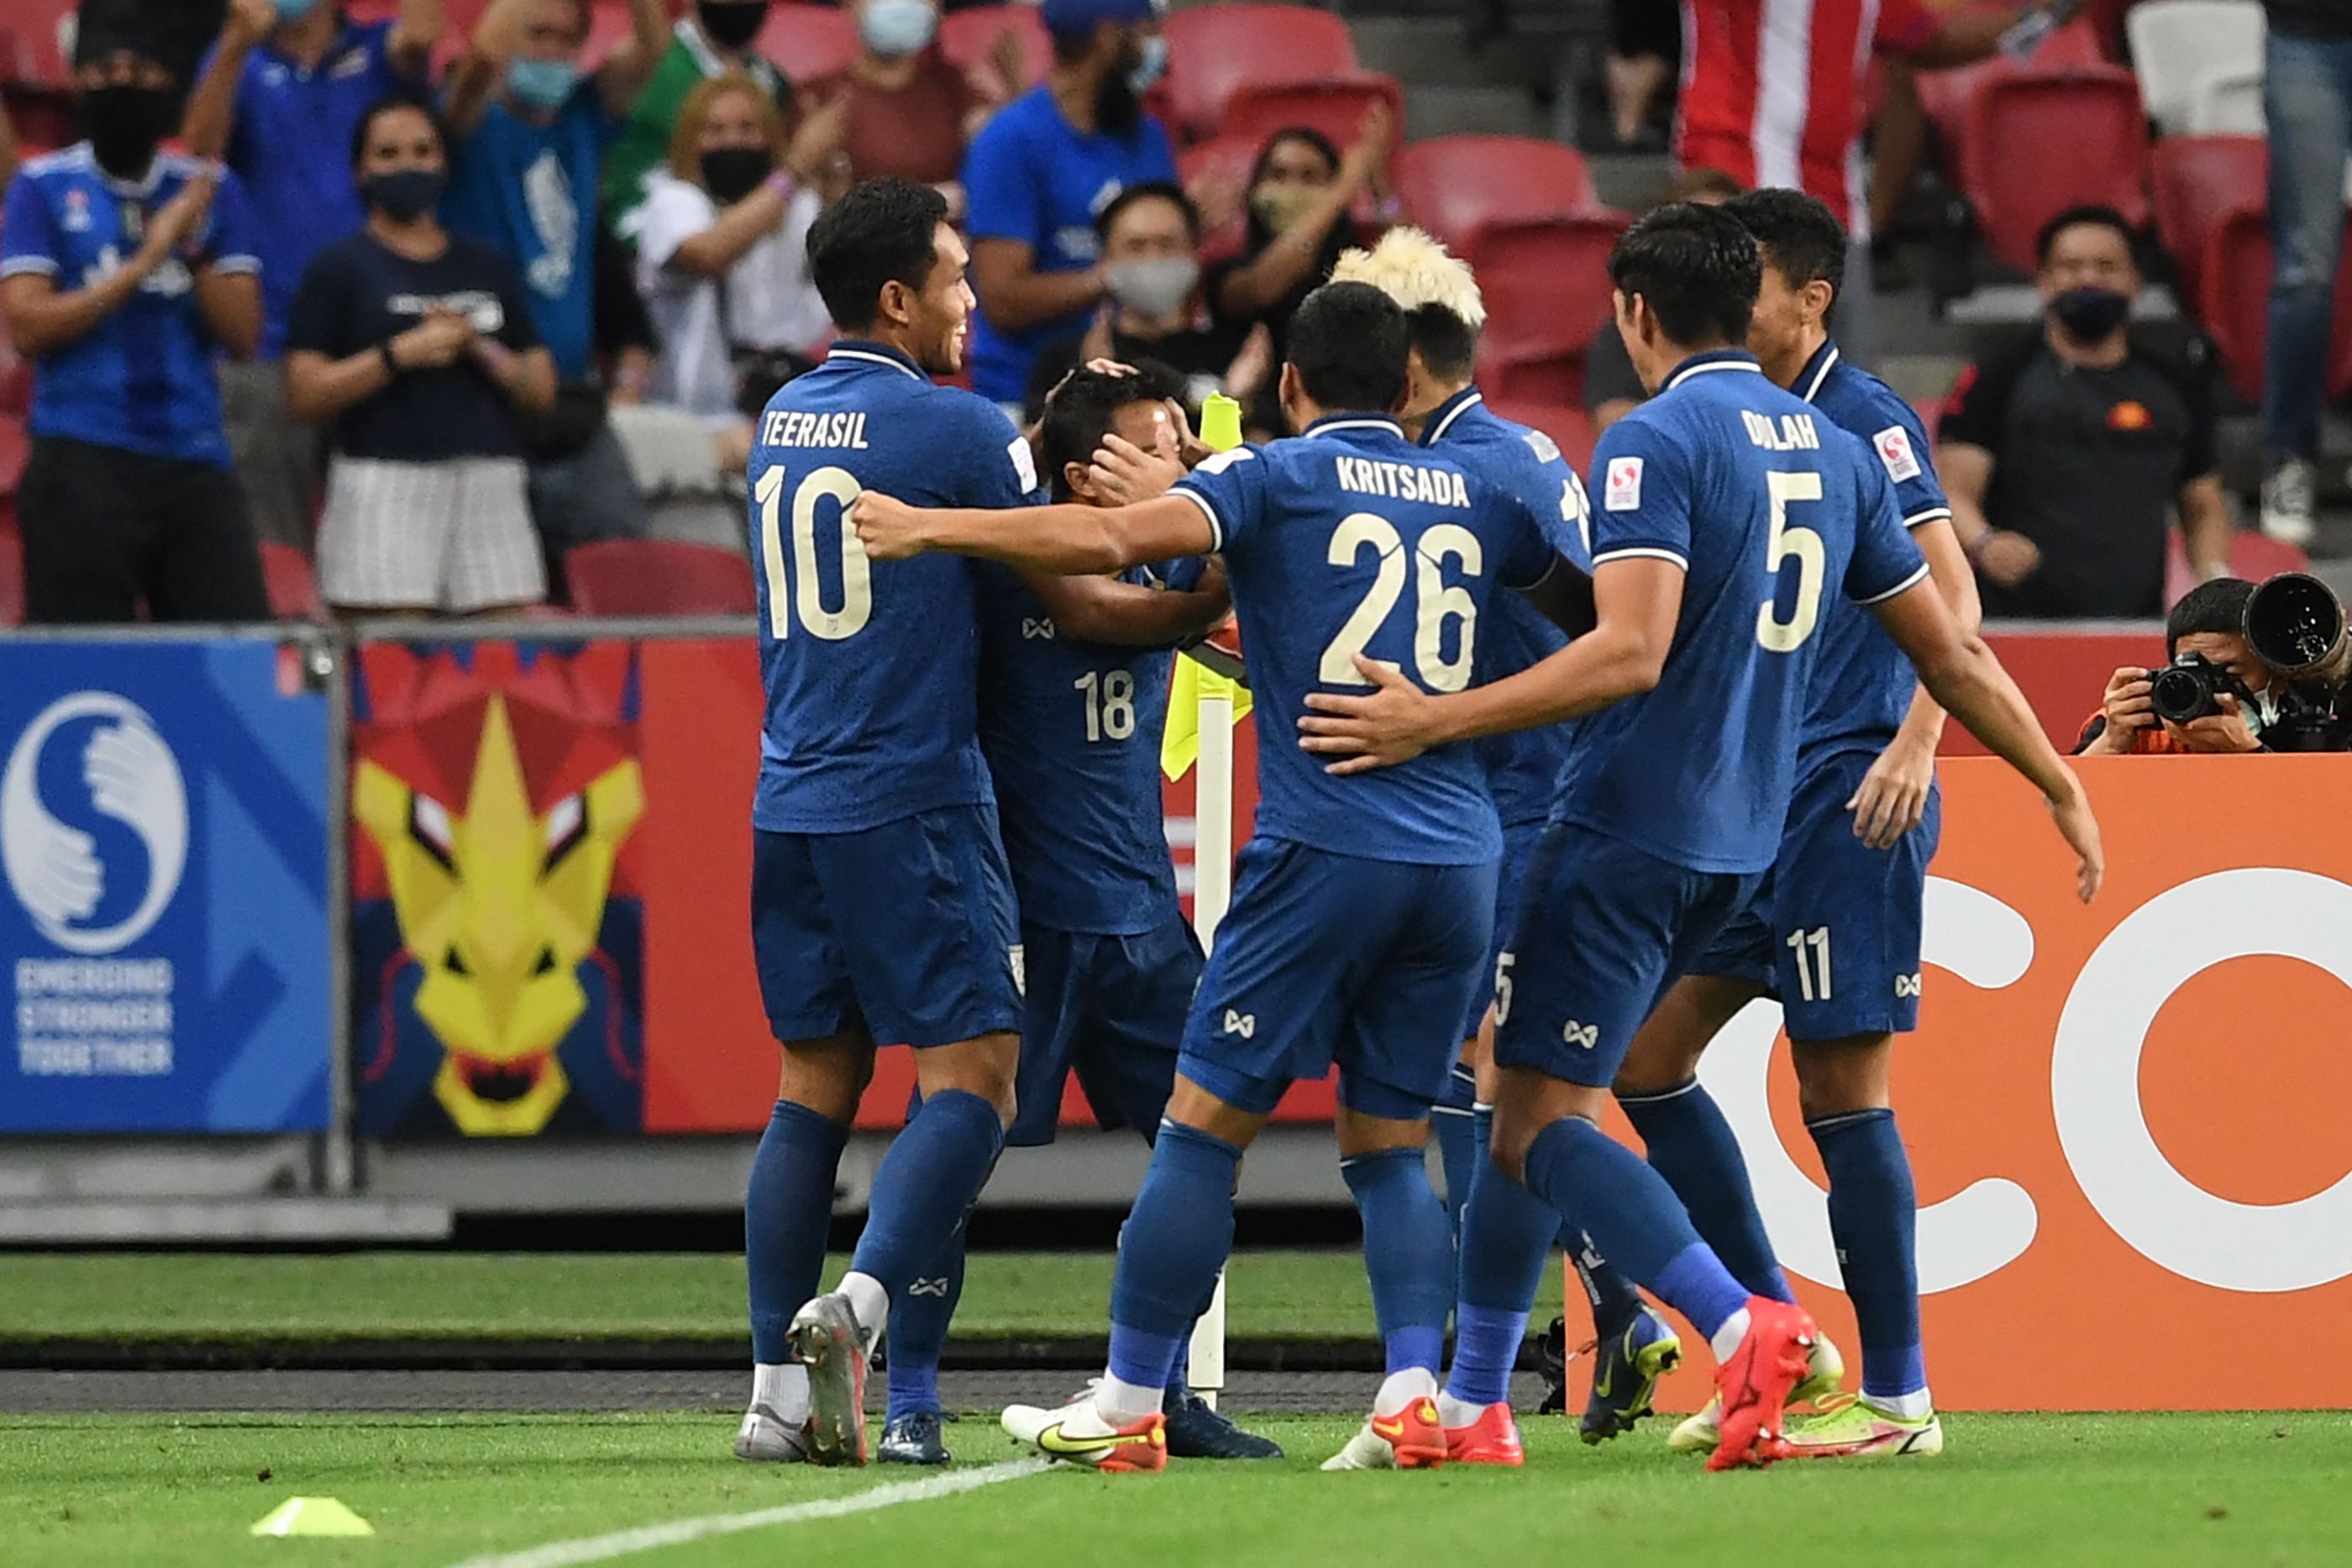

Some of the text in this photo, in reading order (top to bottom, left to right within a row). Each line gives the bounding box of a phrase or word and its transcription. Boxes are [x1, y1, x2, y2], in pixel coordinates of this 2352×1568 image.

[763, 411, 869, 448] TEERASIL
[1336, 456, 1471, 508] KRITSADA
[755, 464, 872, 640] 10
[1756, 470, 1824, 652] 5
[1319, 512, 1483, 693] 26
[1074, 669, 1135, 742] 18
[1495, 951, 1515, 1026] 5
[1787, 926, 1831, 1001] 11
